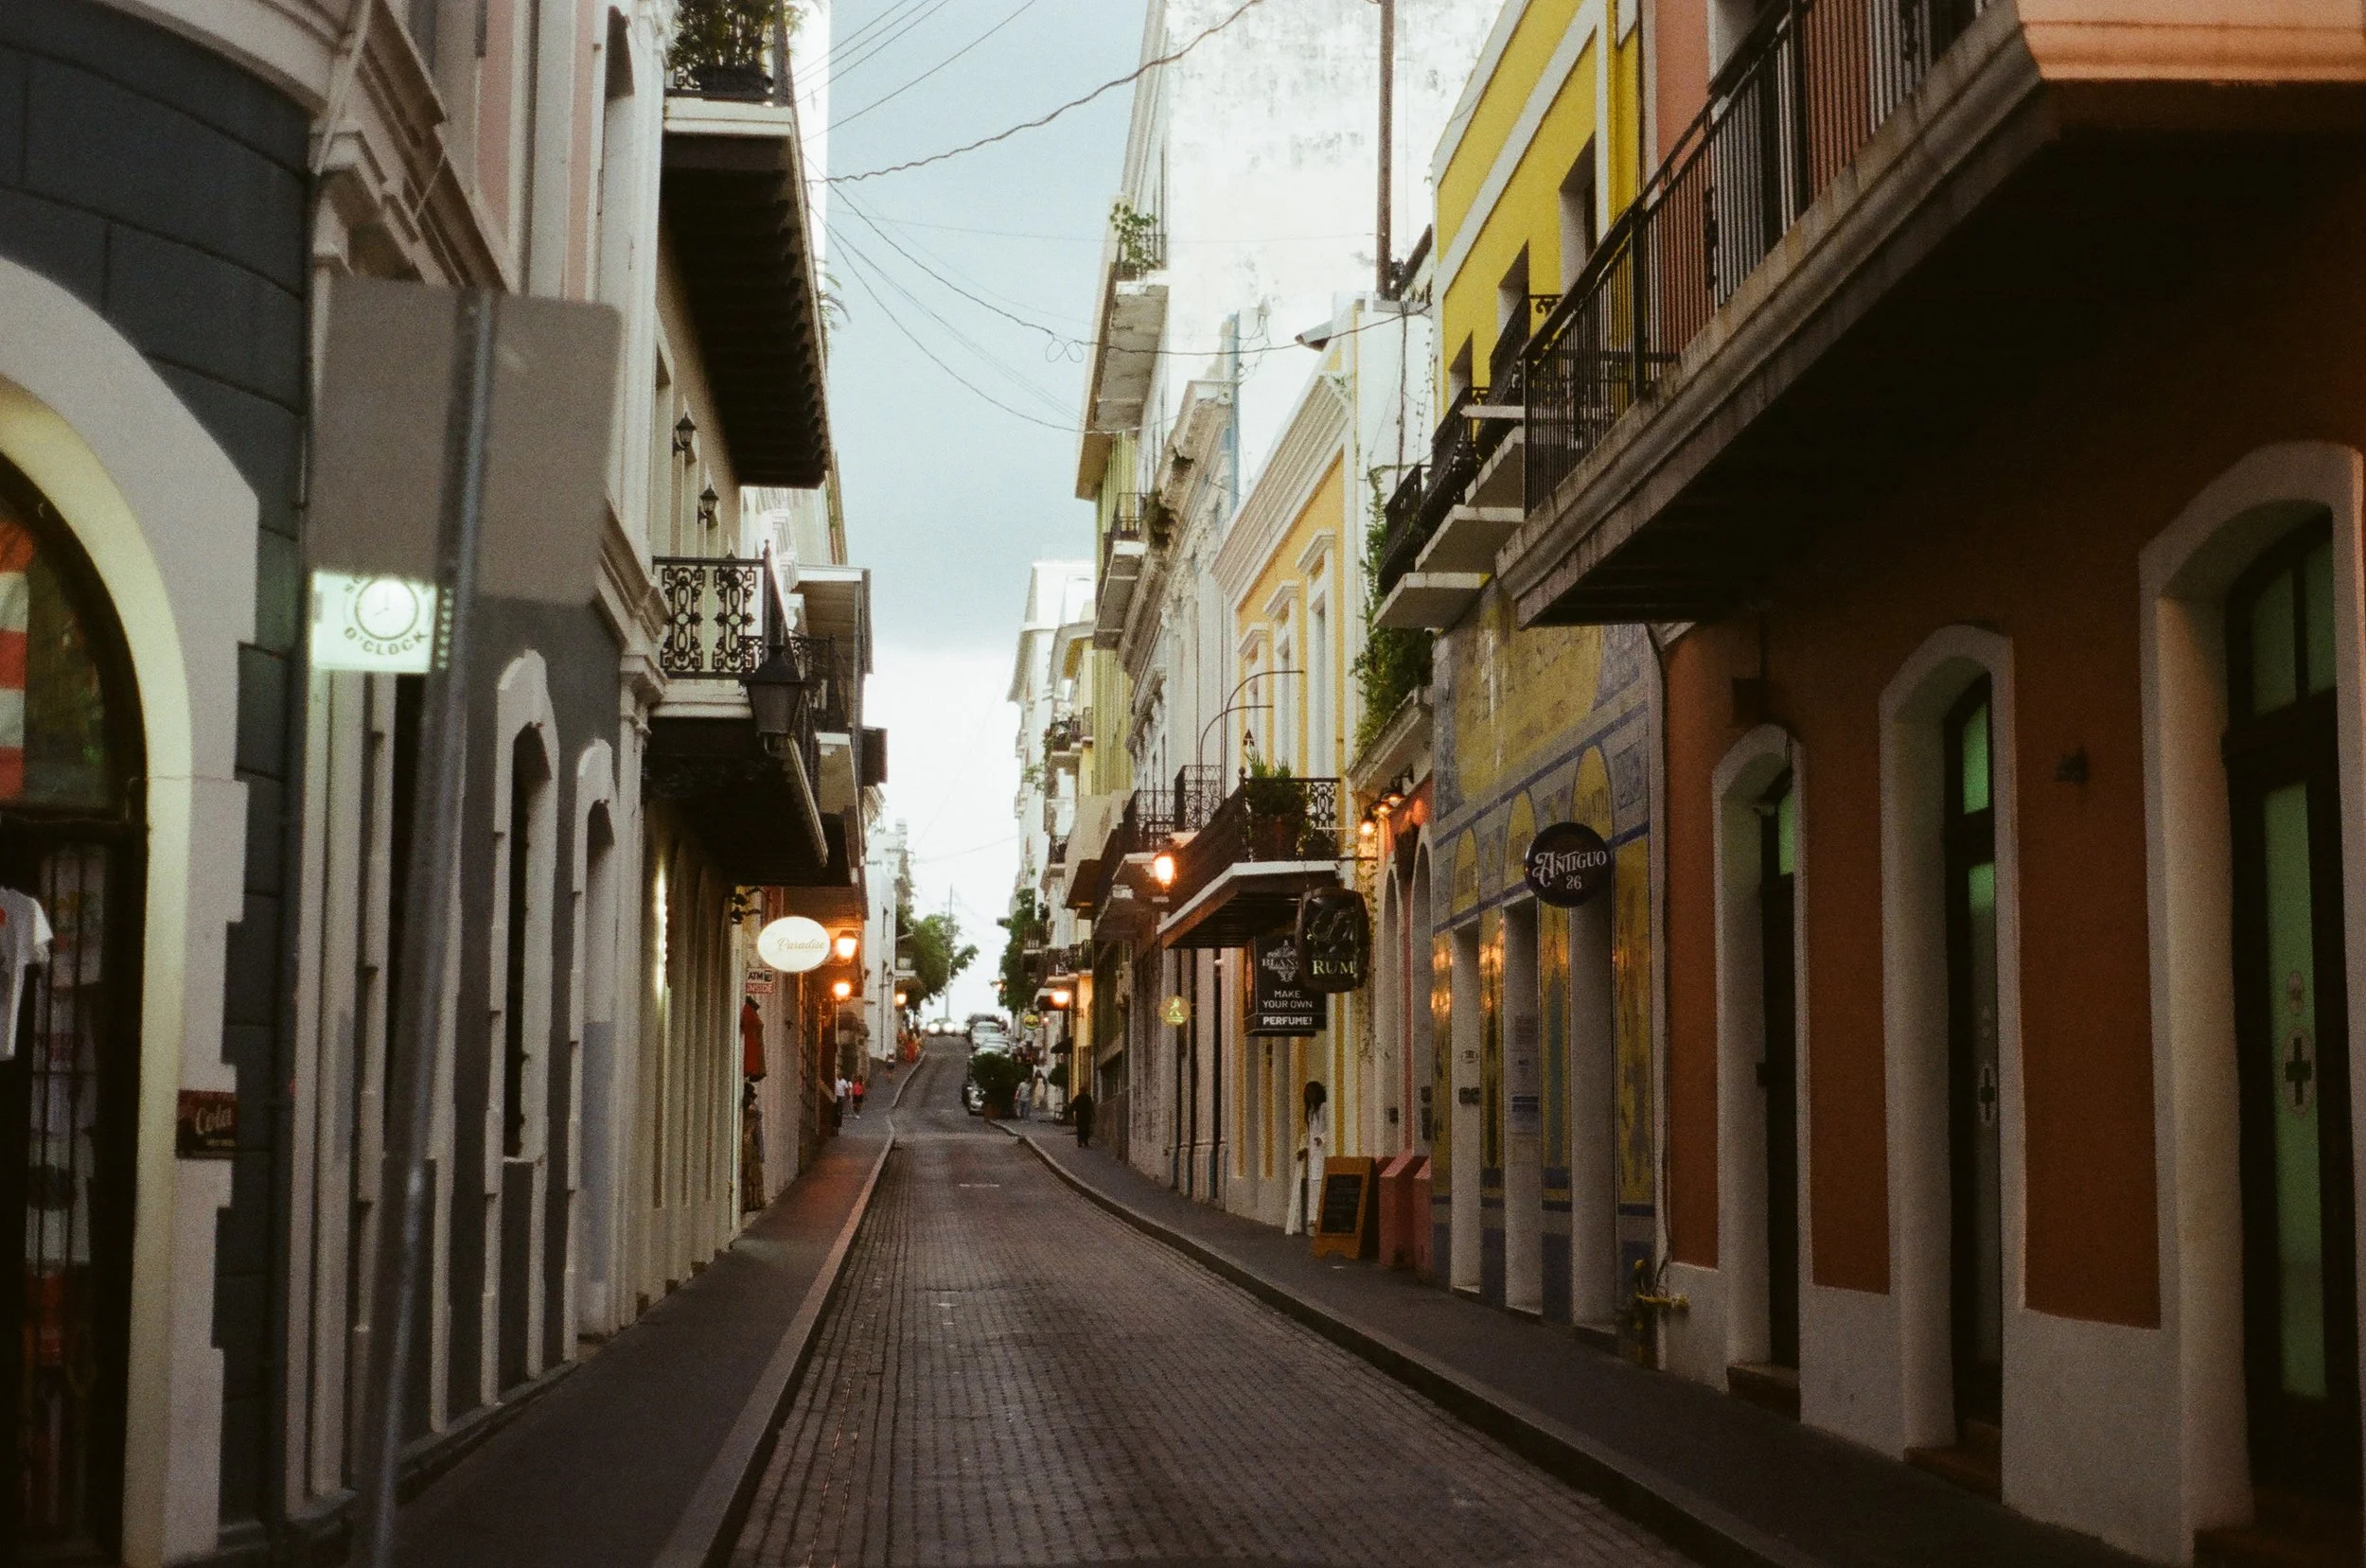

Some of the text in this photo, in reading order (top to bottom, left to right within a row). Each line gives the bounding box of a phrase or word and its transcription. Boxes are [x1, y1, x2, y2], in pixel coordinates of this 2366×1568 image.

[344, 626, 430, 656] O'CLOCK
[1565, 874, 1582, 890] 26
[777, 937, 825, 952] Paradise
[1312, 960, 1355, 976] RUM
[748, 971, 764, 980] ATM
[747, 983, 773, 993] INSIDE
[1274, 990, 1301, 998] MAKE
[1262, 999, 1313, 1009] YOUR OWN
[1262, 1015, 1313, 1026] PERFUME!
